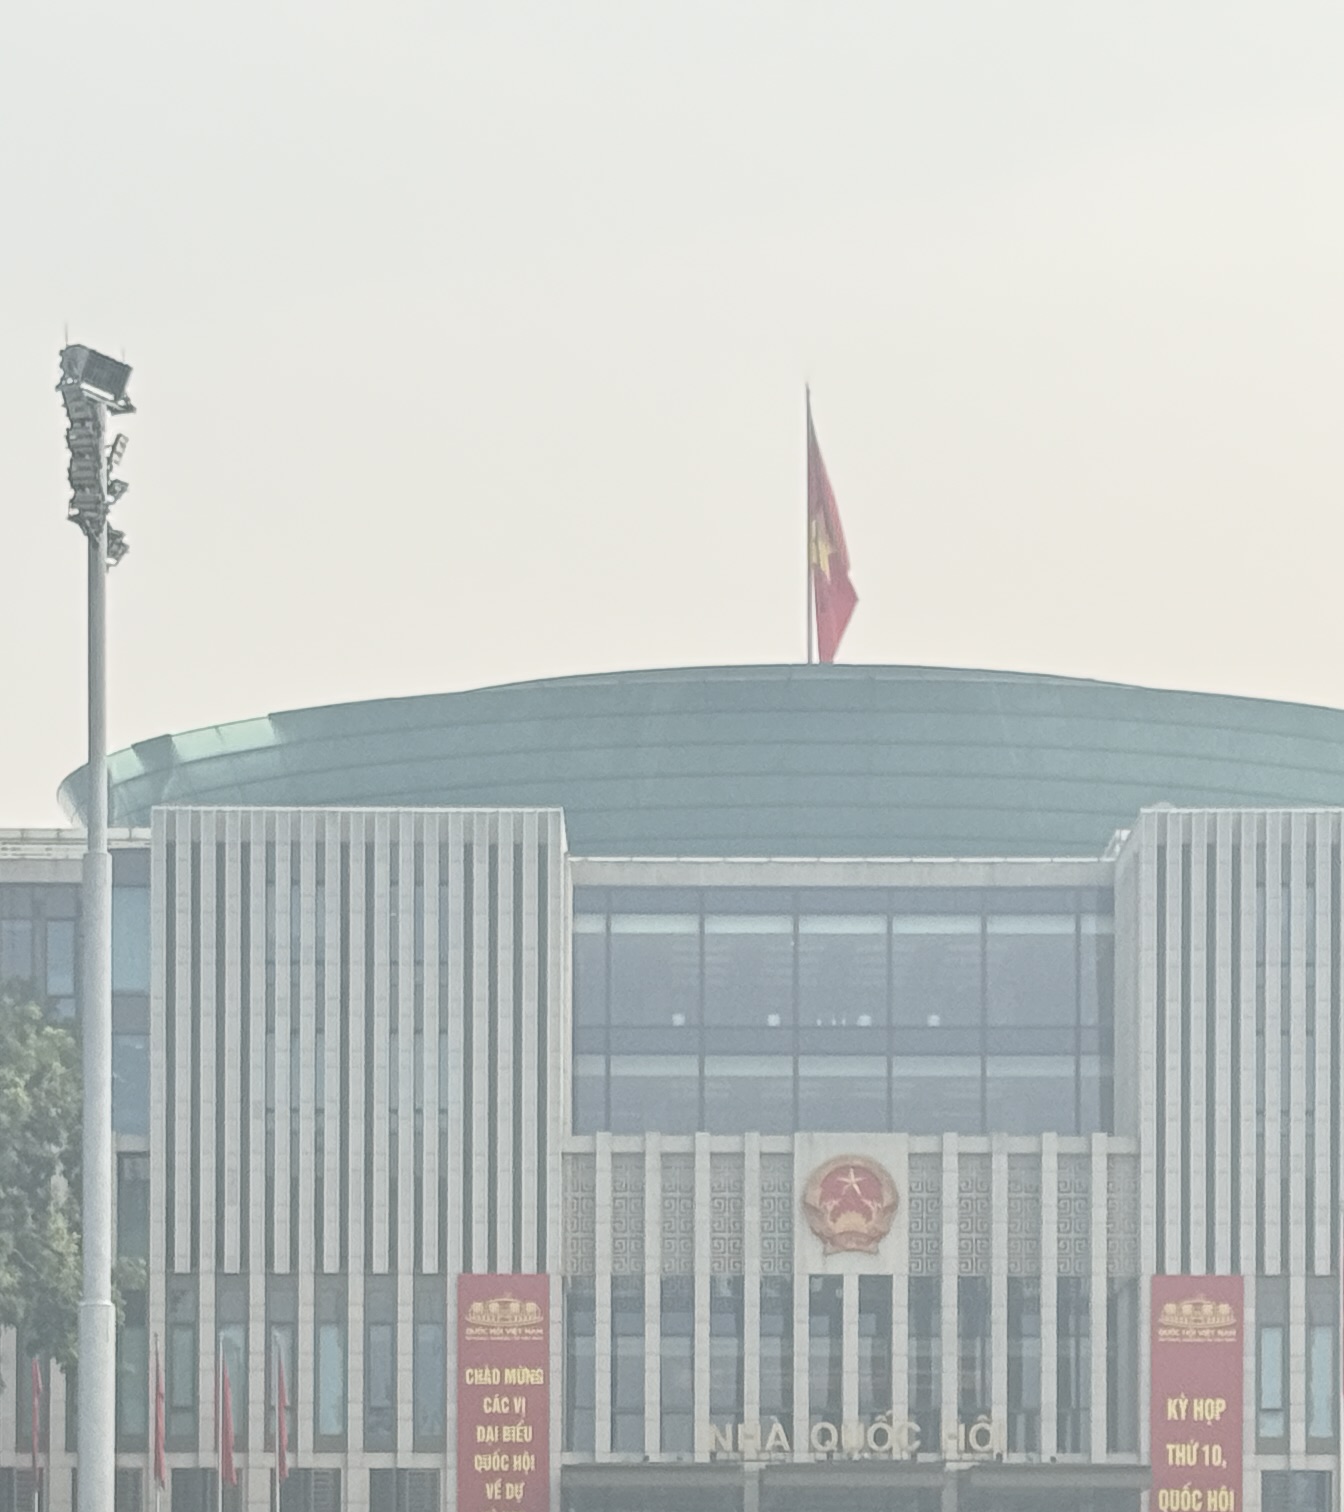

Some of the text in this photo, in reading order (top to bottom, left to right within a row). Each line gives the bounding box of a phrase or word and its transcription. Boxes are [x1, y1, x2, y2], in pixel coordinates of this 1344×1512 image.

[465, 1364, 501, 1386] CHÀO
[483, 1393, 510, 1415] CÁC
[1193, 1397, 1227, 1426] HỌP
[474, 1448, 535, 1475] QUỐC HỘI
[1166, 1439, 1227, 1469] THỨ 10,
